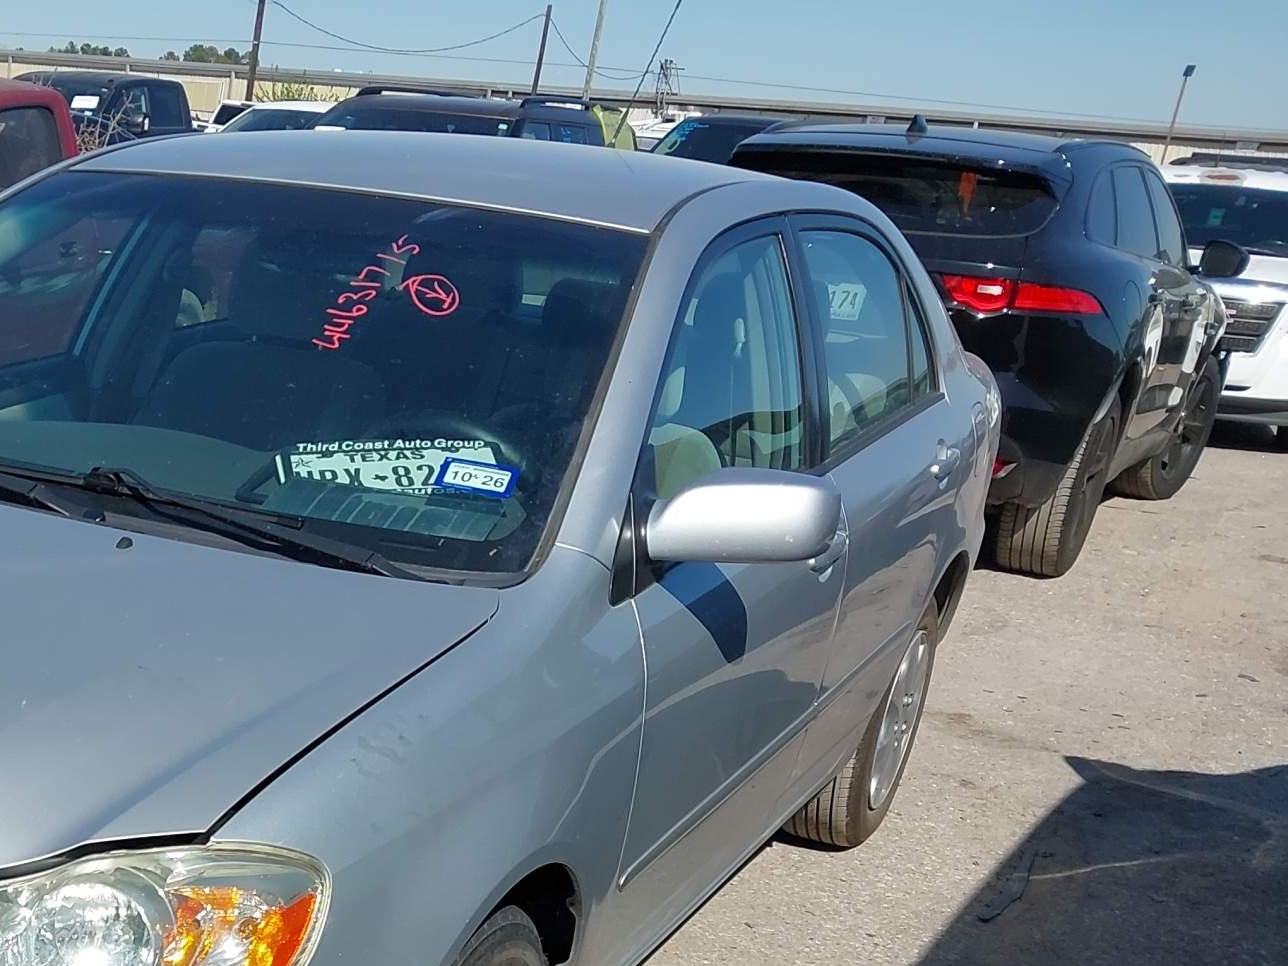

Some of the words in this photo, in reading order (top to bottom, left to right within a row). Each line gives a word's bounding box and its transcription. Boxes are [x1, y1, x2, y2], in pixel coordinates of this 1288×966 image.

[312, 234, 420, 349] 44631715
[296, 441, 339, 452] Third
[341, 440, 390, 451] Coast
[392, 438, 432, 449] Auto
[434, 438, 485, 450] Group
[342, 450, 425, 463] TEXAS
